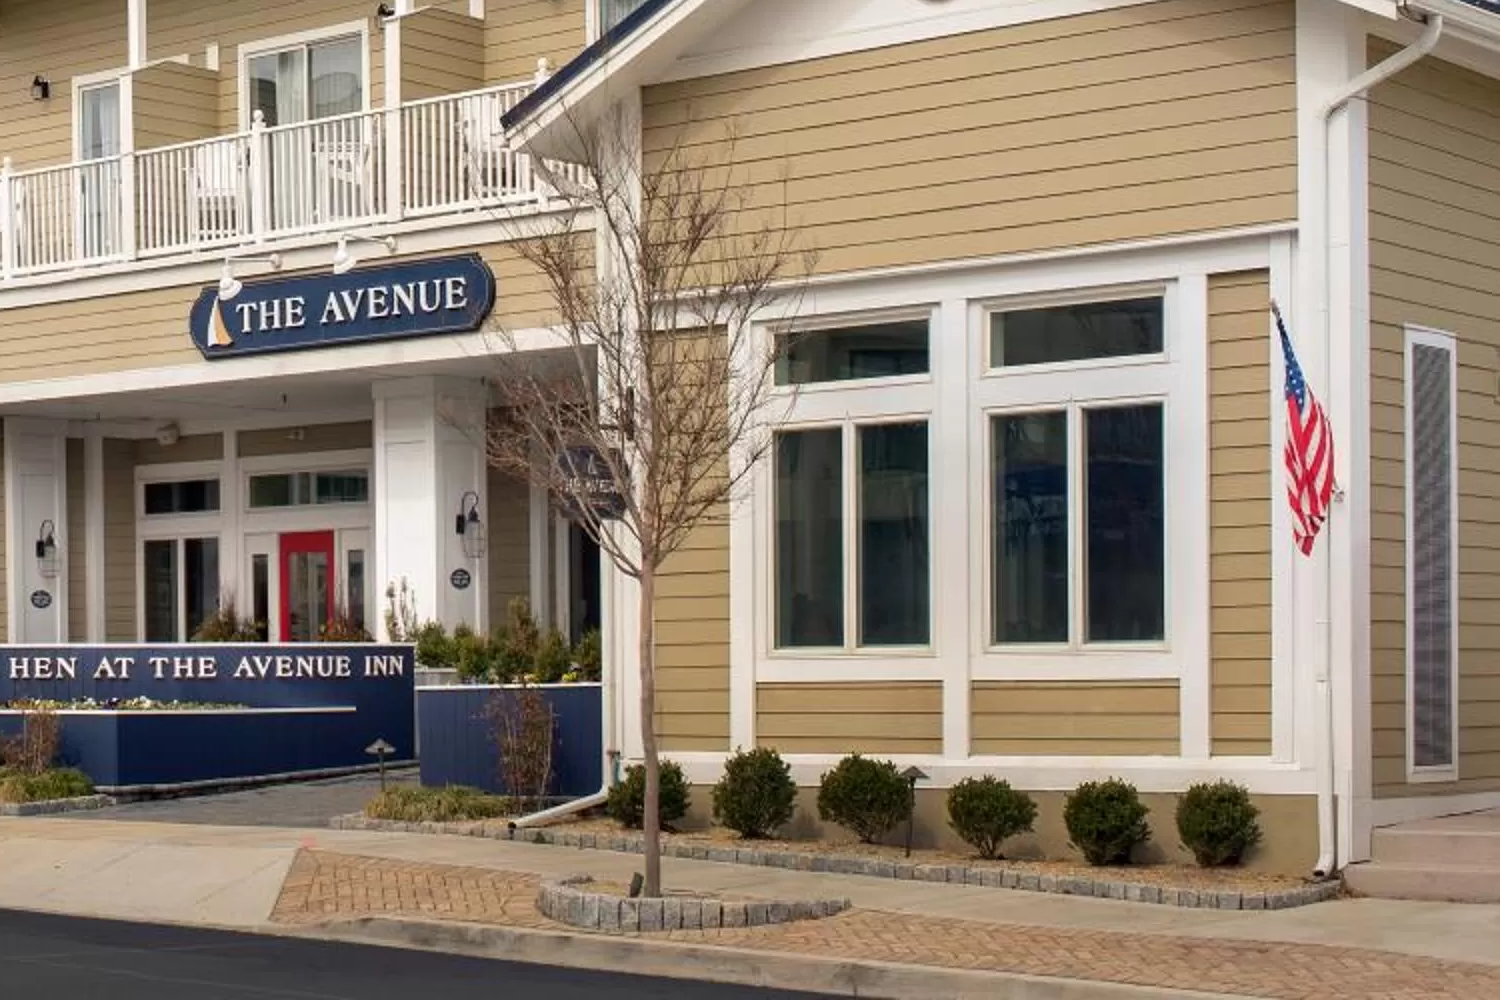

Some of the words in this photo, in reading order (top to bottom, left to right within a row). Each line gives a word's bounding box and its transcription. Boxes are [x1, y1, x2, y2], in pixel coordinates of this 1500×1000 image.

[236, 297, 305, 334] THE
[320, 277, 468, 325] AVENUE
[9, 657, 77, 680] HEN
[93, 656, 134, 679] AT
[148, 656, 217, 679] THE
[233, 655, 351, 678] AVENUE
[364, 655, 404, 676] INN
